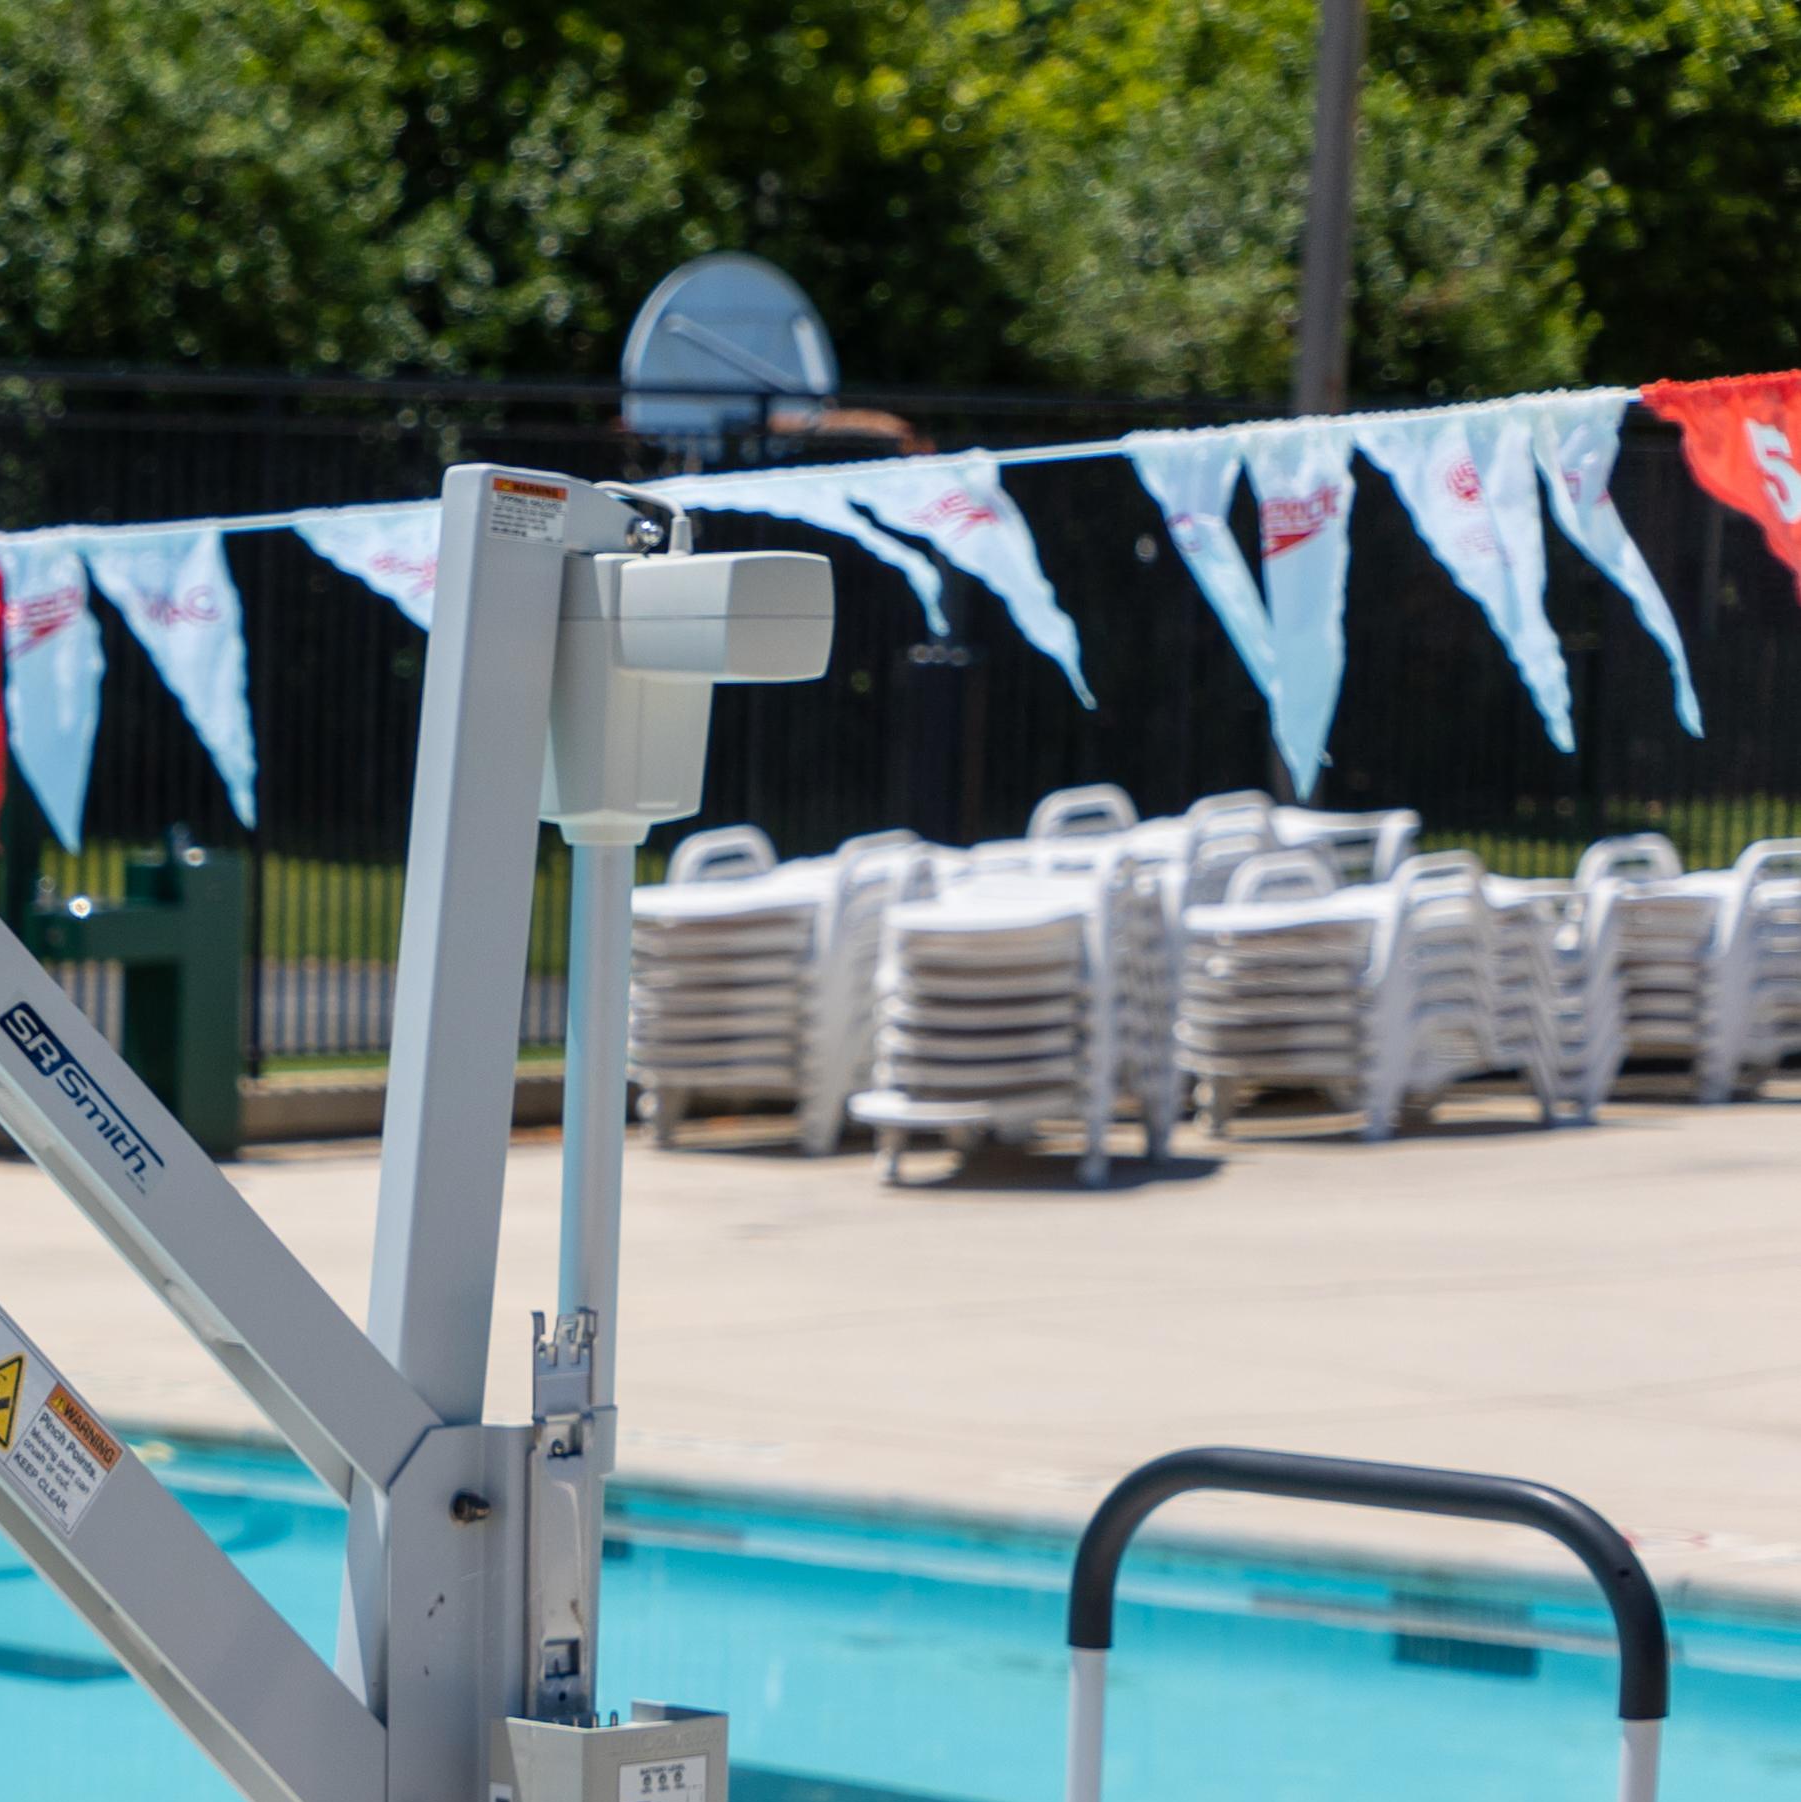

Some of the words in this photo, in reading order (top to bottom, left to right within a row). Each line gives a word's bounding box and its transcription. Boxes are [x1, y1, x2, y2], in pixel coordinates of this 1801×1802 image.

[38, 1410, 68, 1446] Pinch
[61, 1401, 115, 1464] WARNING
[13, 1449, 39, 1481] KEEP
